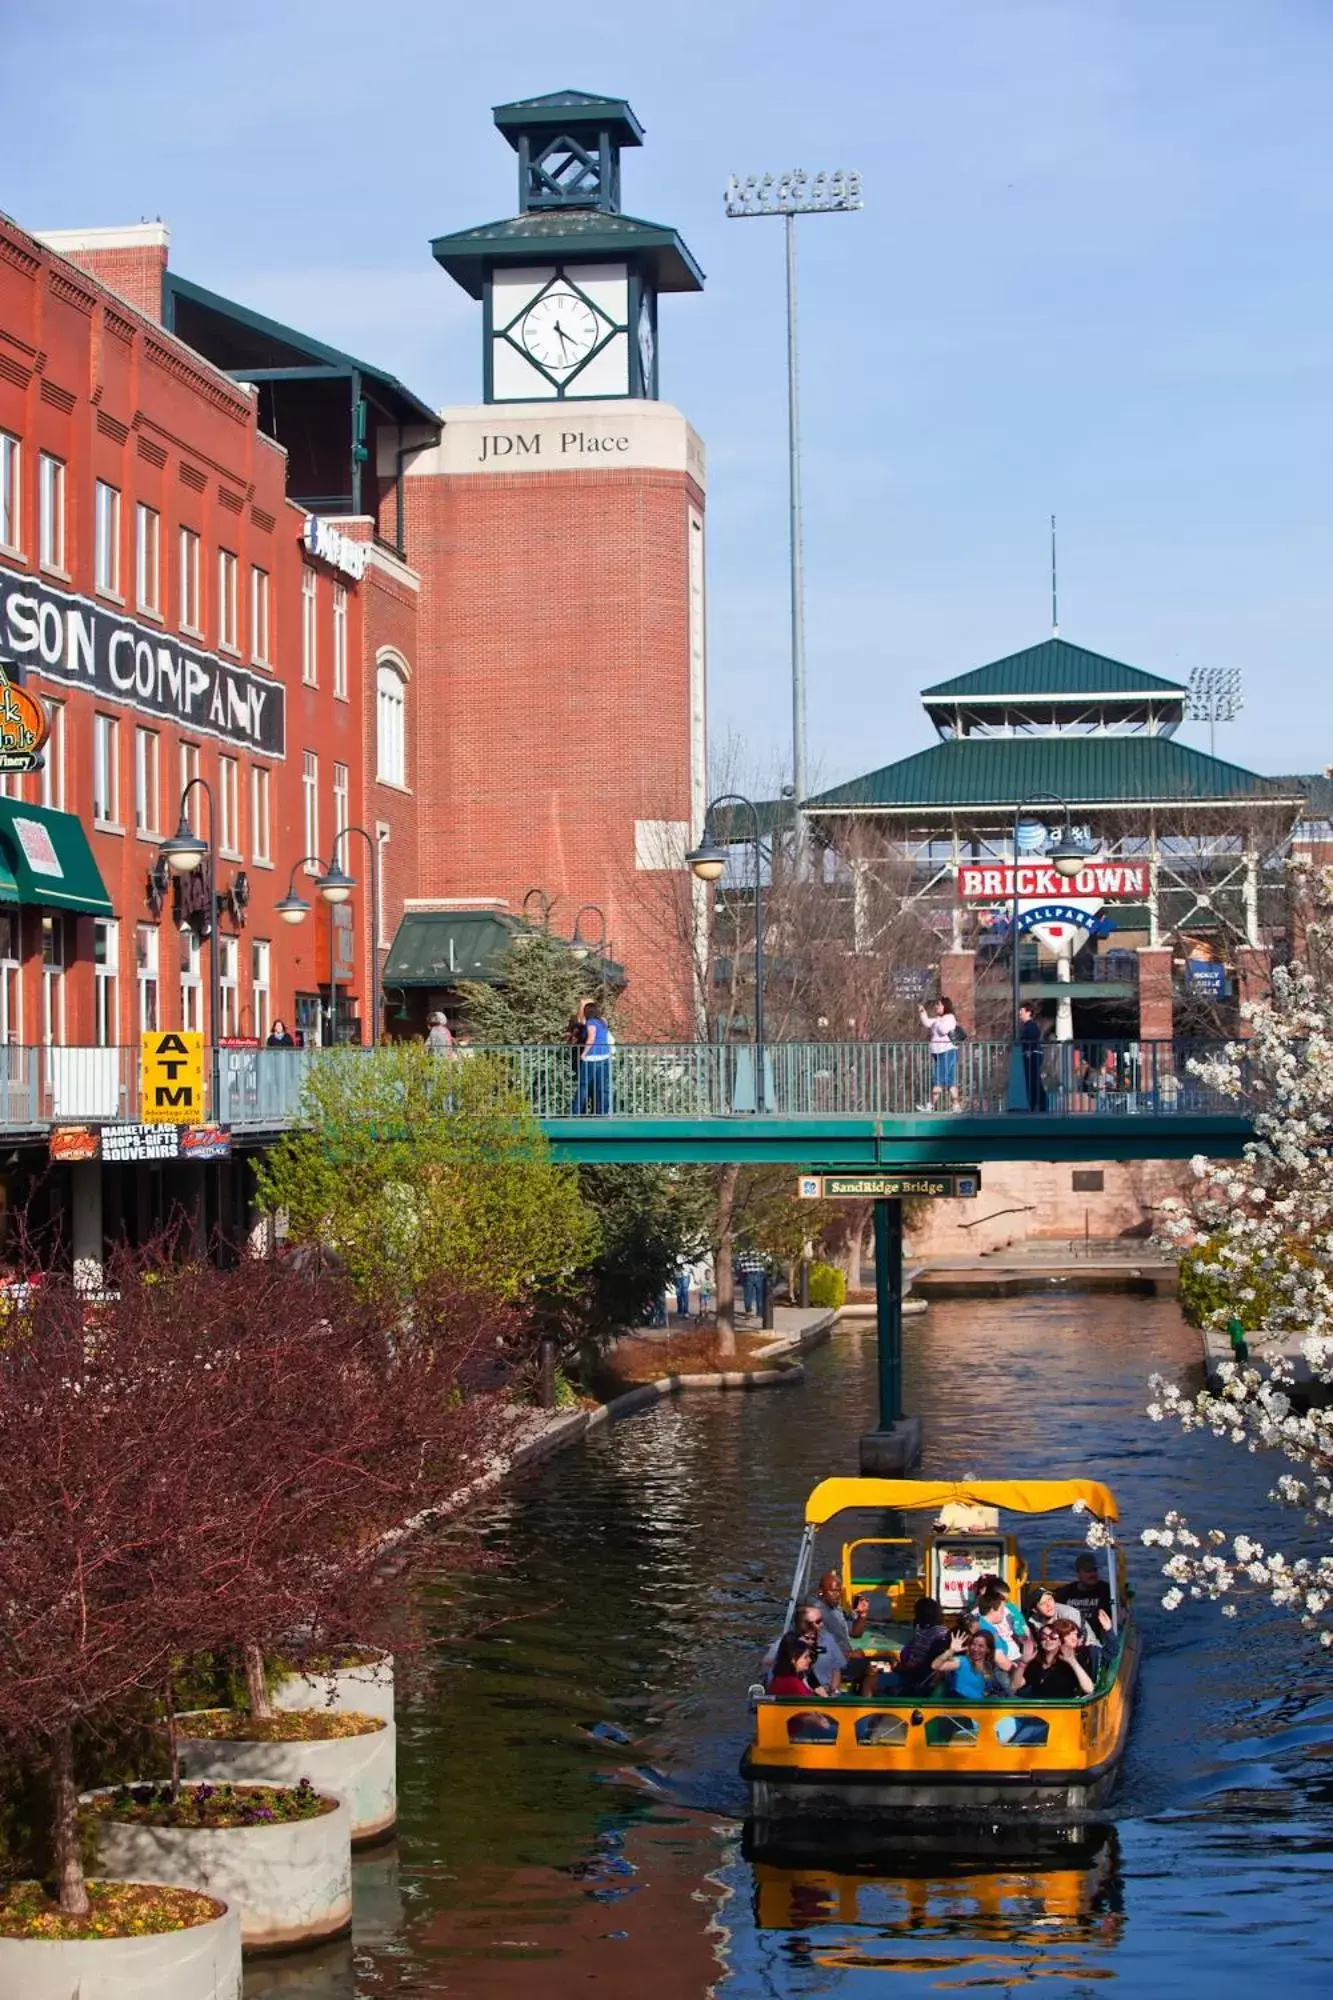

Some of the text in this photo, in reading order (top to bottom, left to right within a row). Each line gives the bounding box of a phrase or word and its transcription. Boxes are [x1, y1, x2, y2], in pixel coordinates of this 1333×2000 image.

[478, 431, 630, 462] JDM Place
[0, 583, 267, 741] SON COMPANY
[963, 867, 1143, 896] BRICKTOWN
[155, 1034, 193, 1107] ATM
[101, 1123, 178, 1138] MARKETPLACE
[102, 1133, 178, 1149] SHOPS-GIFTS
[102, 1145, 179, 1161] SOUVENIRS
[831, 1180, 945, 1195] SandRidge Bridge
